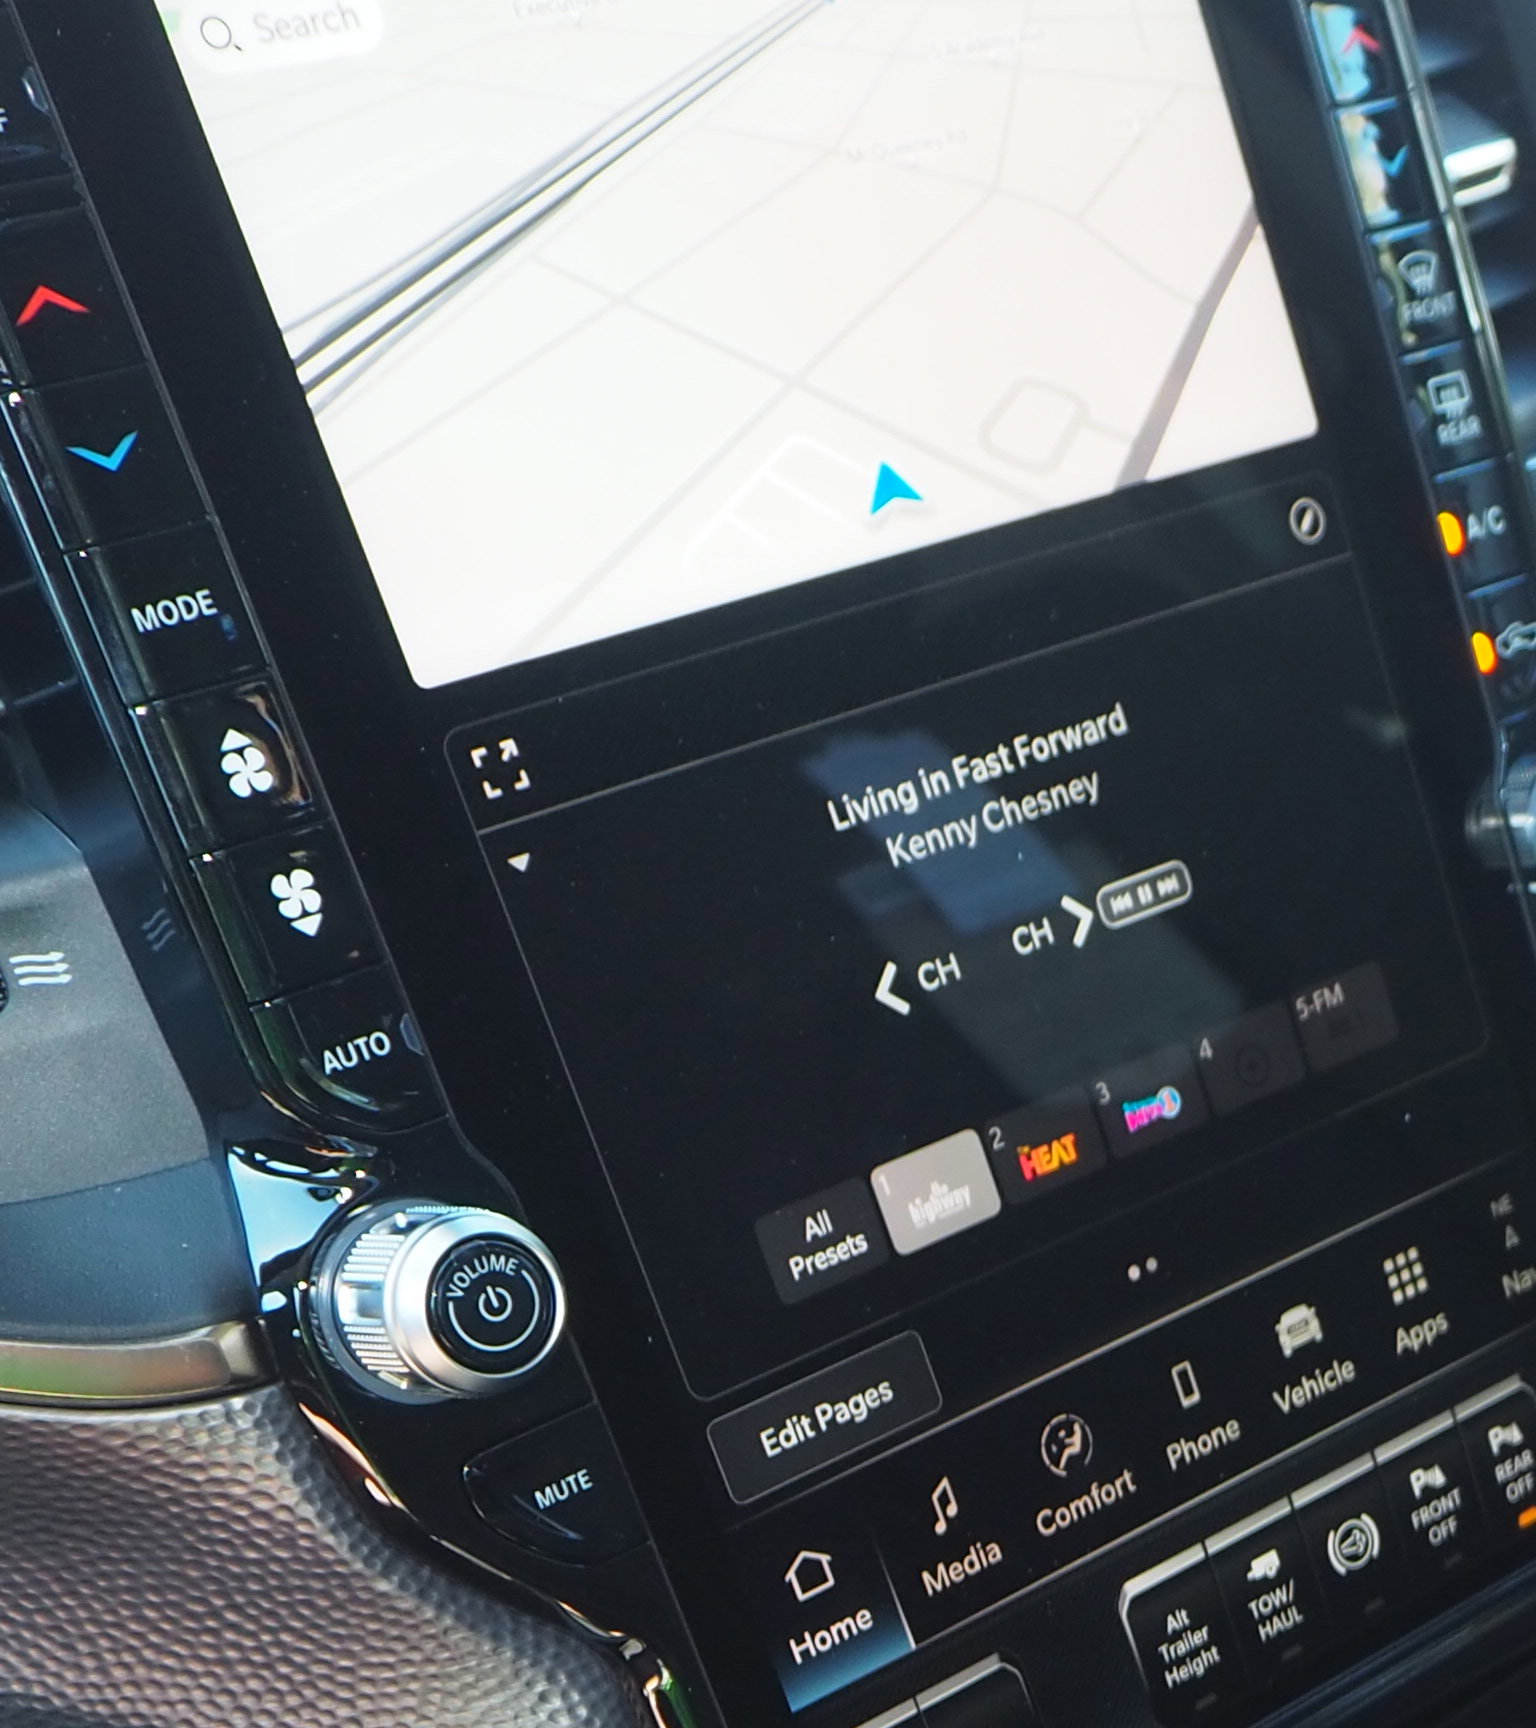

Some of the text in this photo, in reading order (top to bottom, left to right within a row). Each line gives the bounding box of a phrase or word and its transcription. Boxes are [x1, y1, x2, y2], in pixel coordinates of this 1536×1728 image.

[252, 2, 360, 44] Search
[1405, 292, 1456, 322] FRONT
[1437, 414, 1481, 443] REAR
[1467, 505, 1504, 541] A/C
[132, 590, 217, 633] MODE
[827, 702, 1128, 831] Living in Fast Forward
[885, 773, 1099, 868] Kenny Chesney
[1012, 918, 1054, 956] CH
[917, 953, 961, 993] CH
[1296, 982, 1345, 1020] 5-FM
[321, 1032, 392, 1075] AUTO
[1200, 1038, 1213, 1060] 4
[1096, 1081, 1110, 1105] 3
[988, 1126, 1005, 1150] 2
[1019, 1133, 1077, 1182] HEAT
[878, 1175, 890, 1196] 1
[909, 1184, 971, 1227] highway
[805, 1209, 832, 1242] All
[445, 1253, 520, 1301] VOLUME
[789, 1233, 868, 1281] Presets
[1395, 1311, 1449, 1355] Apps
[1273, 1356, 1355, 1413] Vehicle
[760, 1380, 894, 1458] Edit Pages
[1167, 1417, 1241, 1472] Phone
[1494, 1449, 1534, 1484] REAR
[534, 1469, 594, 1510] MUTE
[1035, 1470, 1137, 1537] Comfort
[1505, 1473, 1535, 1503] OFF
[1411, 1487, 1462, 1531] FRONT
[1428, 1517, 1457, 1546] OFF
[921, 1542, 1003, 1598] Media
[789, 1610, 874, 1664] Home
[1166, 1608, 1190, 1634] Alt
[1259, 1605, 1304, 1642] HAUL
[1159, 1625, 1208, 1663] Trailer
[1164, 1645, 1220, 1688] Height
